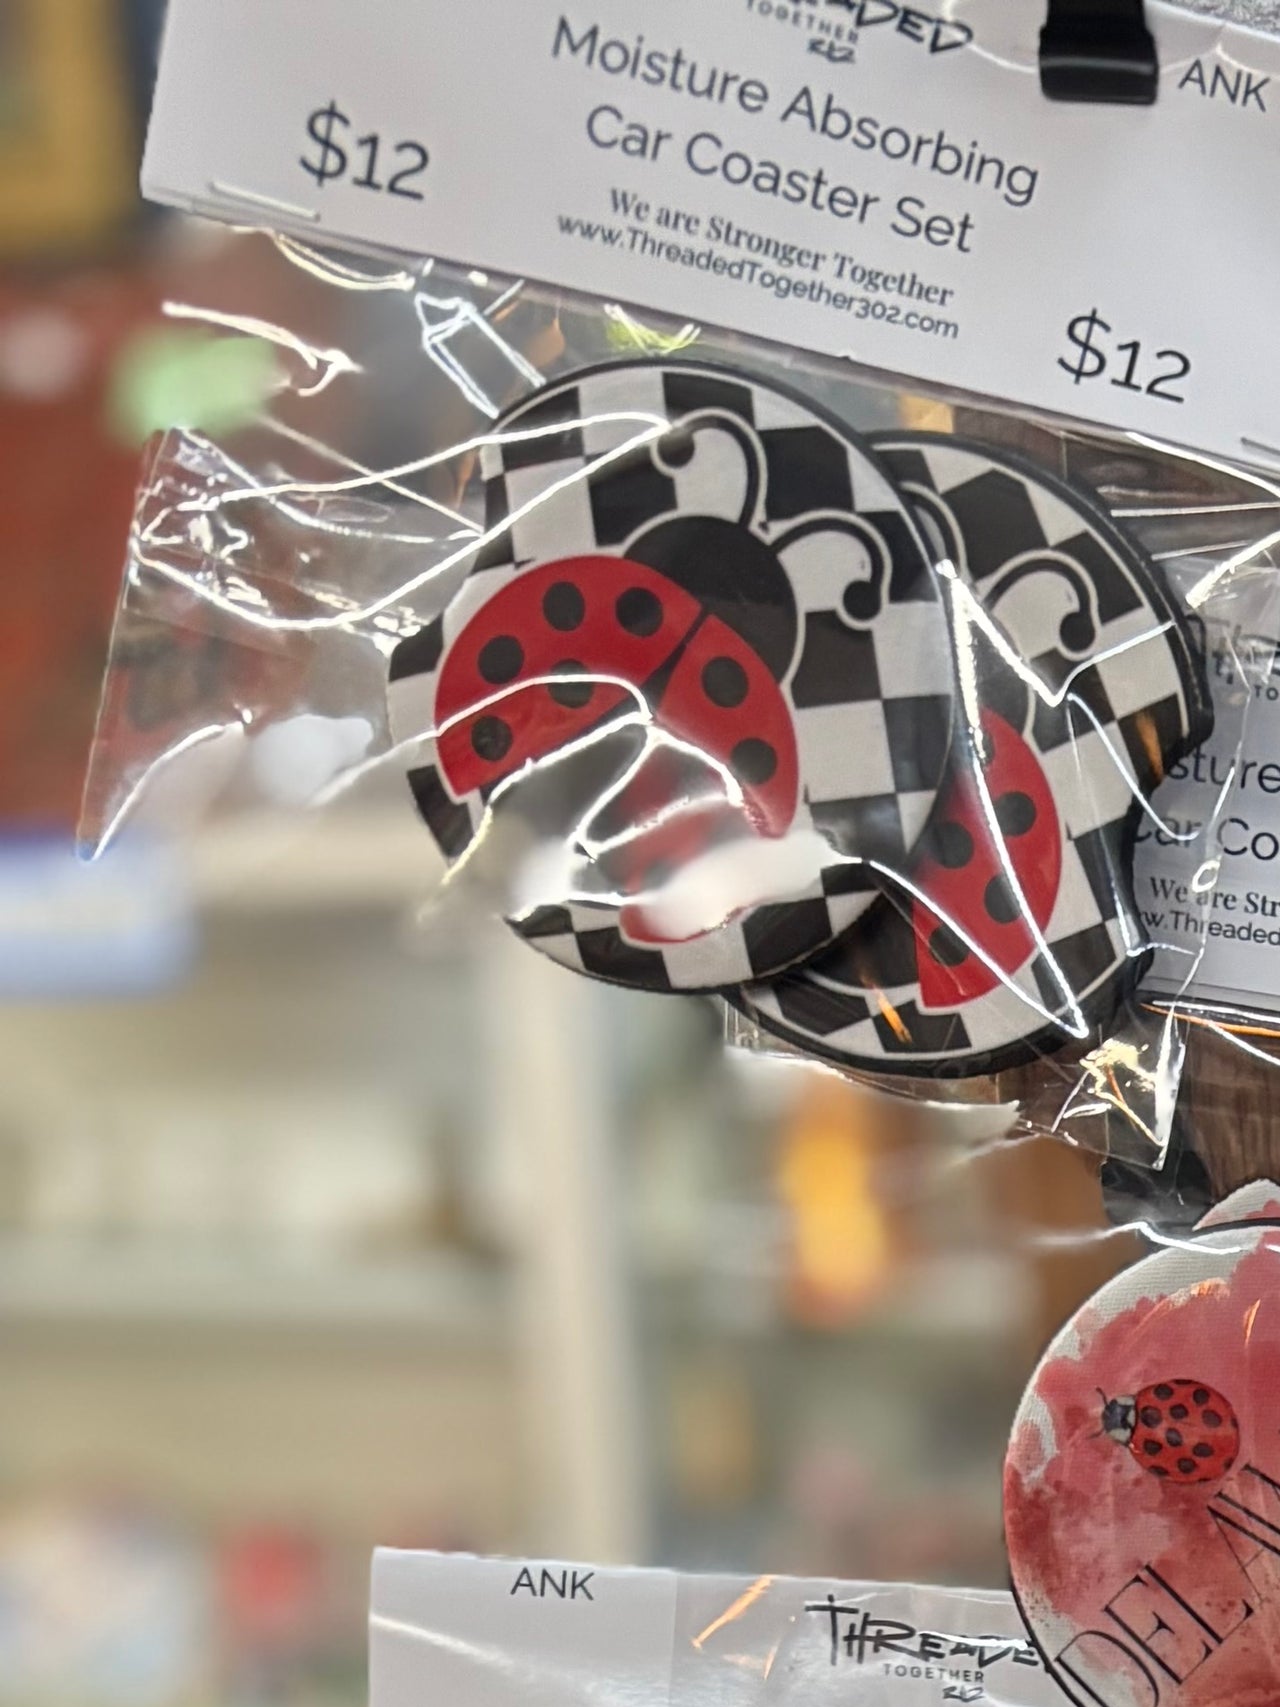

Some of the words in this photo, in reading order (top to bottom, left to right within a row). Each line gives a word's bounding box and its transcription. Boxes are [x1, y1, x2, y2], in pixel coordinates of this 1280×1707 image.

[551, 15, 768, 113] Moisture
[780, 86, 1037, 207] Absorbing
[1179, 58, 1271, 112] ANK
[300, 101, 430, 201] $12
[587, 105, 672, 161] Car
[685, 132, 880, 225] Coaster
[891, 196, 975, 253] Set
[557, 214, 960, 339] www.ThreadedTogether302.com
[610, 188, 650, 222] We
[656, 208, 700, 238] are
[706, 214, 827, 273] Stronger
[834, 252, 955, 308] Together
[1057, 307, 1191, 404] $12
[1150, 876, 1188, 903] We
[511, 1567, 595, 1601] ANK
[883, 1663, 985, 1684] TOGETHER
